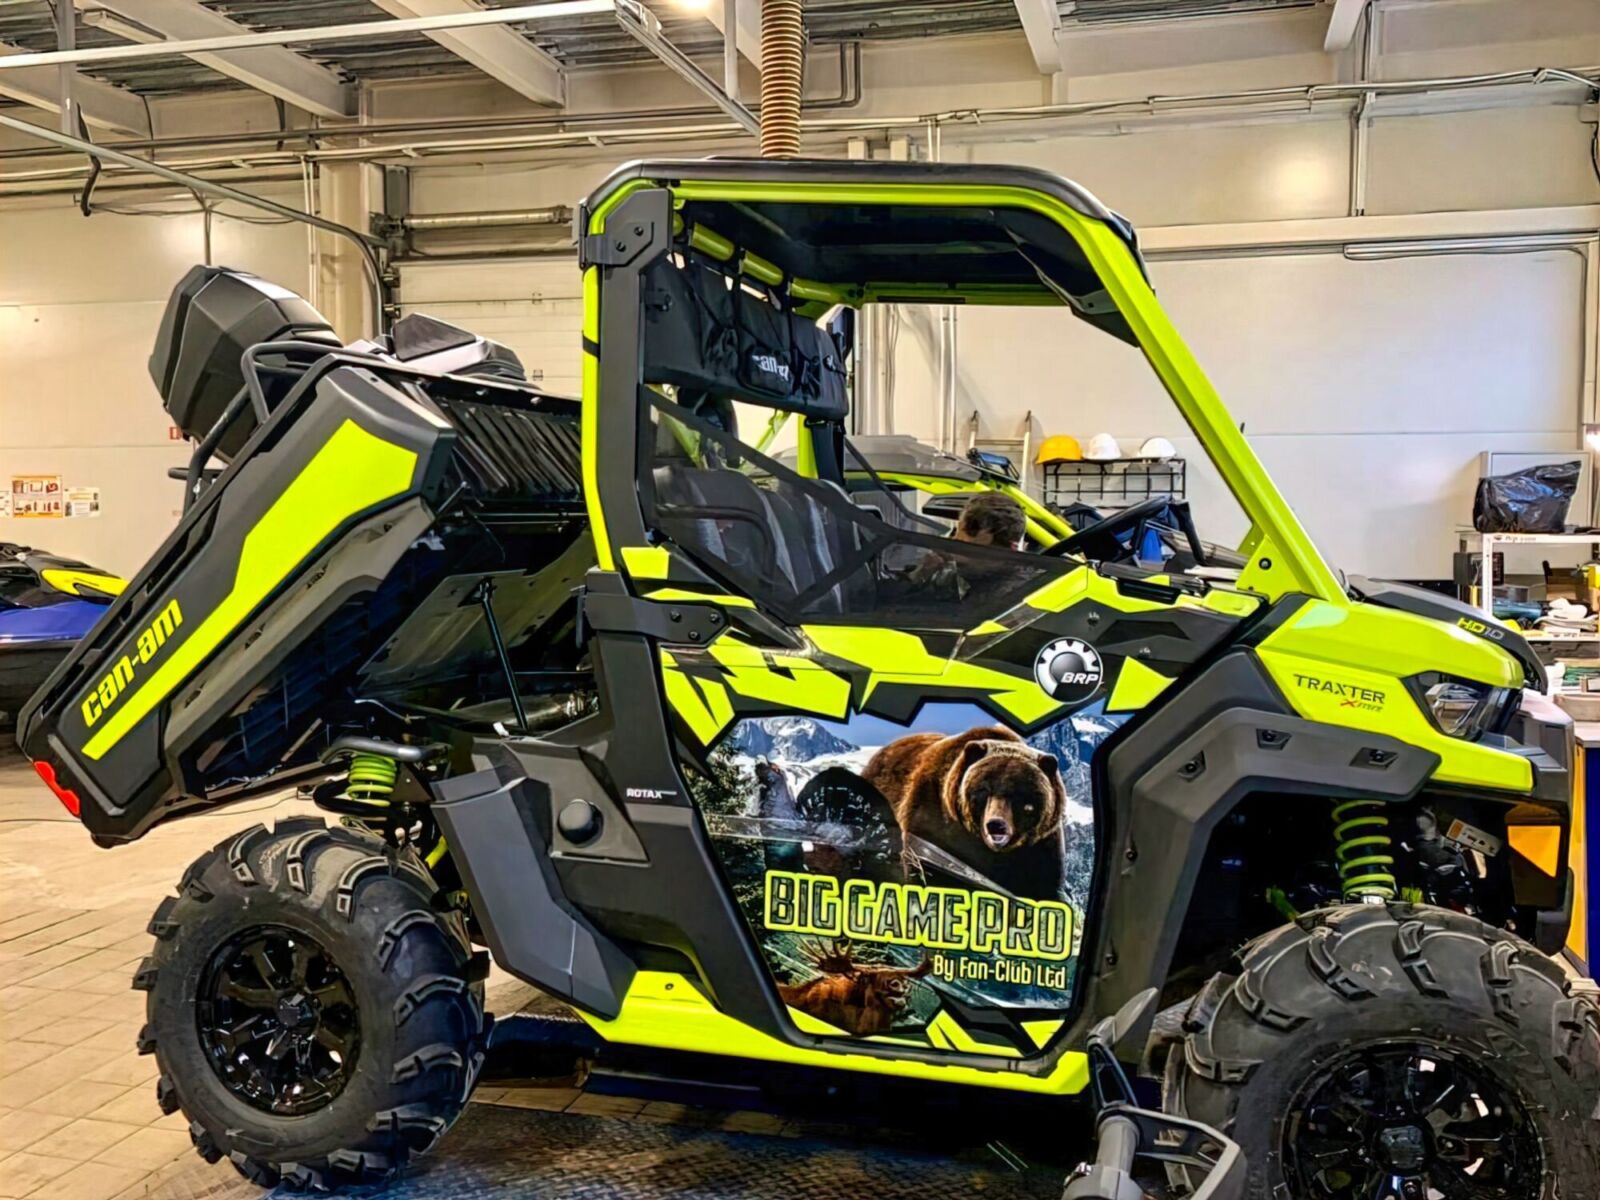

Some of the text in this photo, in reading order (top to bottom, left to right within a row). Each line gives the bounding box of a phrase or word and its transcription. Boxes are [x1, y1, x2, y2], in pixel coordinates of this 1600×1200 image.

[1457, 617, 1504, 640] HD10
[81, 598, 183, 728] can-am
[1060, 671, 1099, 685] BRP
[1293, 673, 1386, 704] TRAXTER
[626, 787, 662, 799] ROTAX
[765, 870, 1074, 960] BIG GAME PRO
[932, 954, 1066, 989] By Fan-Club Ltd
